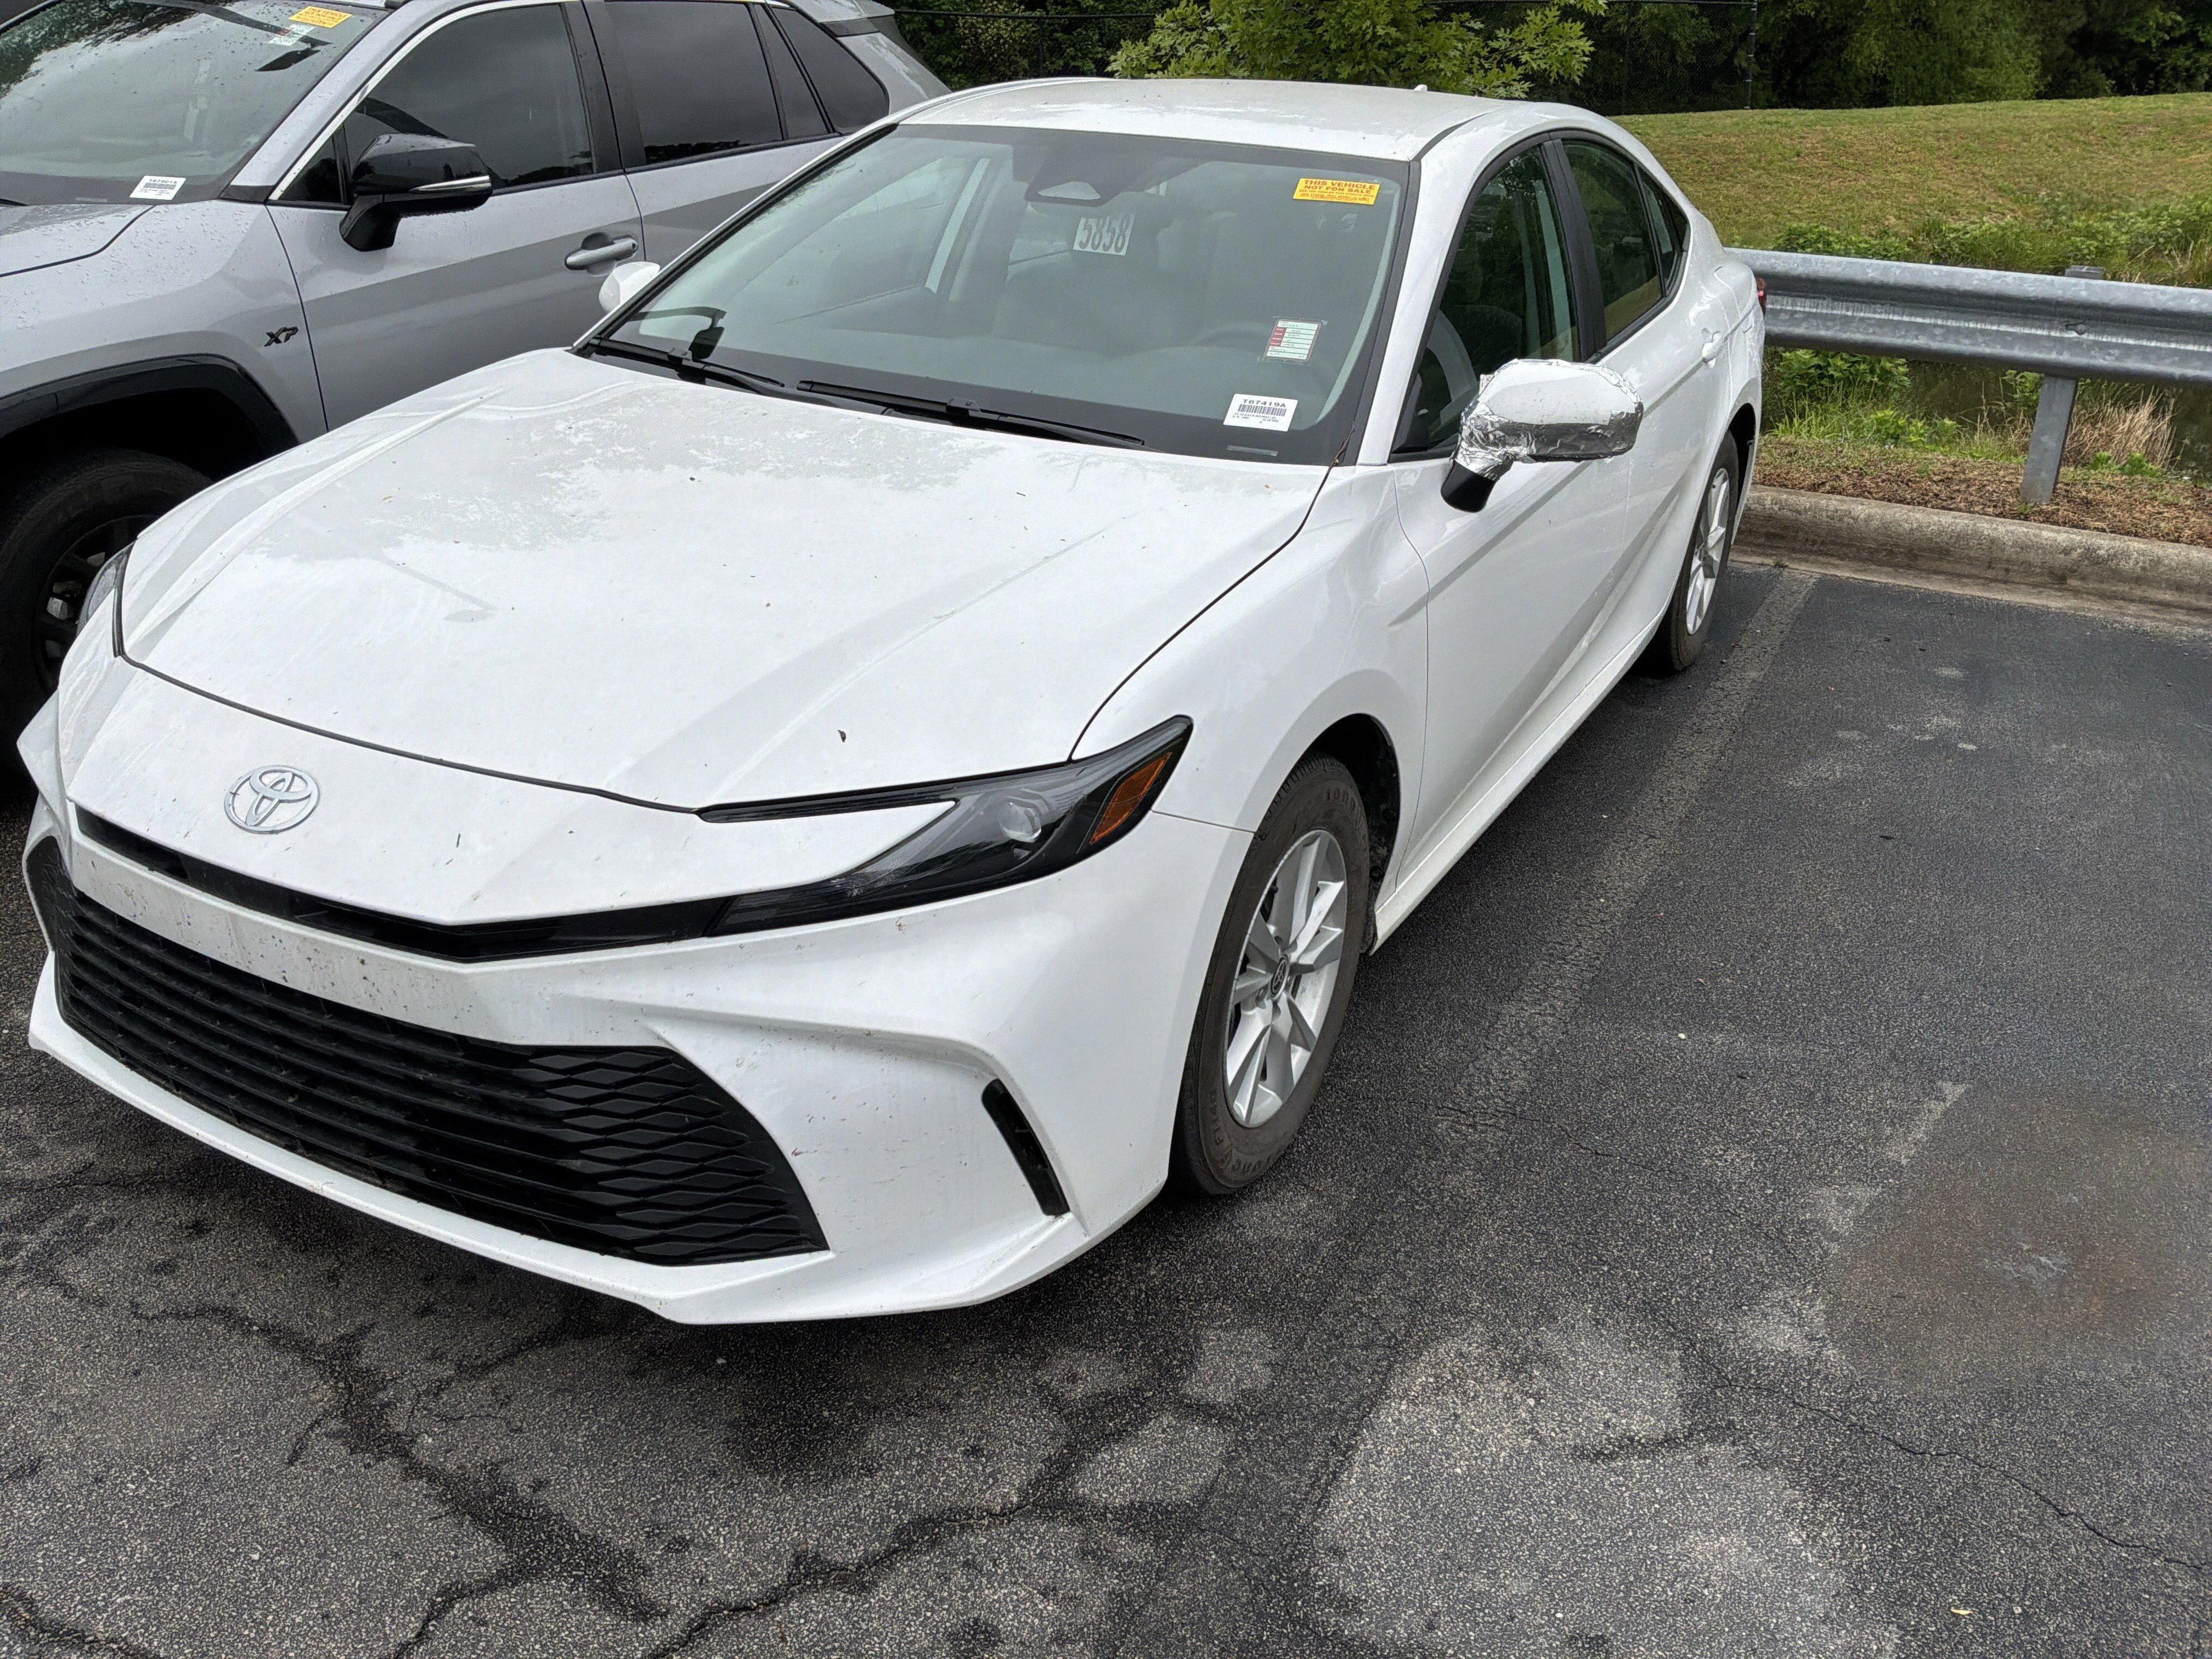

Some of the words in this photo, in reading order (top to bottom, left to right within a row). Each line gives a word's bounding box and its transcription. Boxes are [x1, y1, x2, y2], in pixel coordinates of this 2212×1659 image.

[1331, 182, 1375, 190] VEHICLE
[1079, 215, 1129, 253] 5858
[1243, 399, 1286, 408] T67419A
